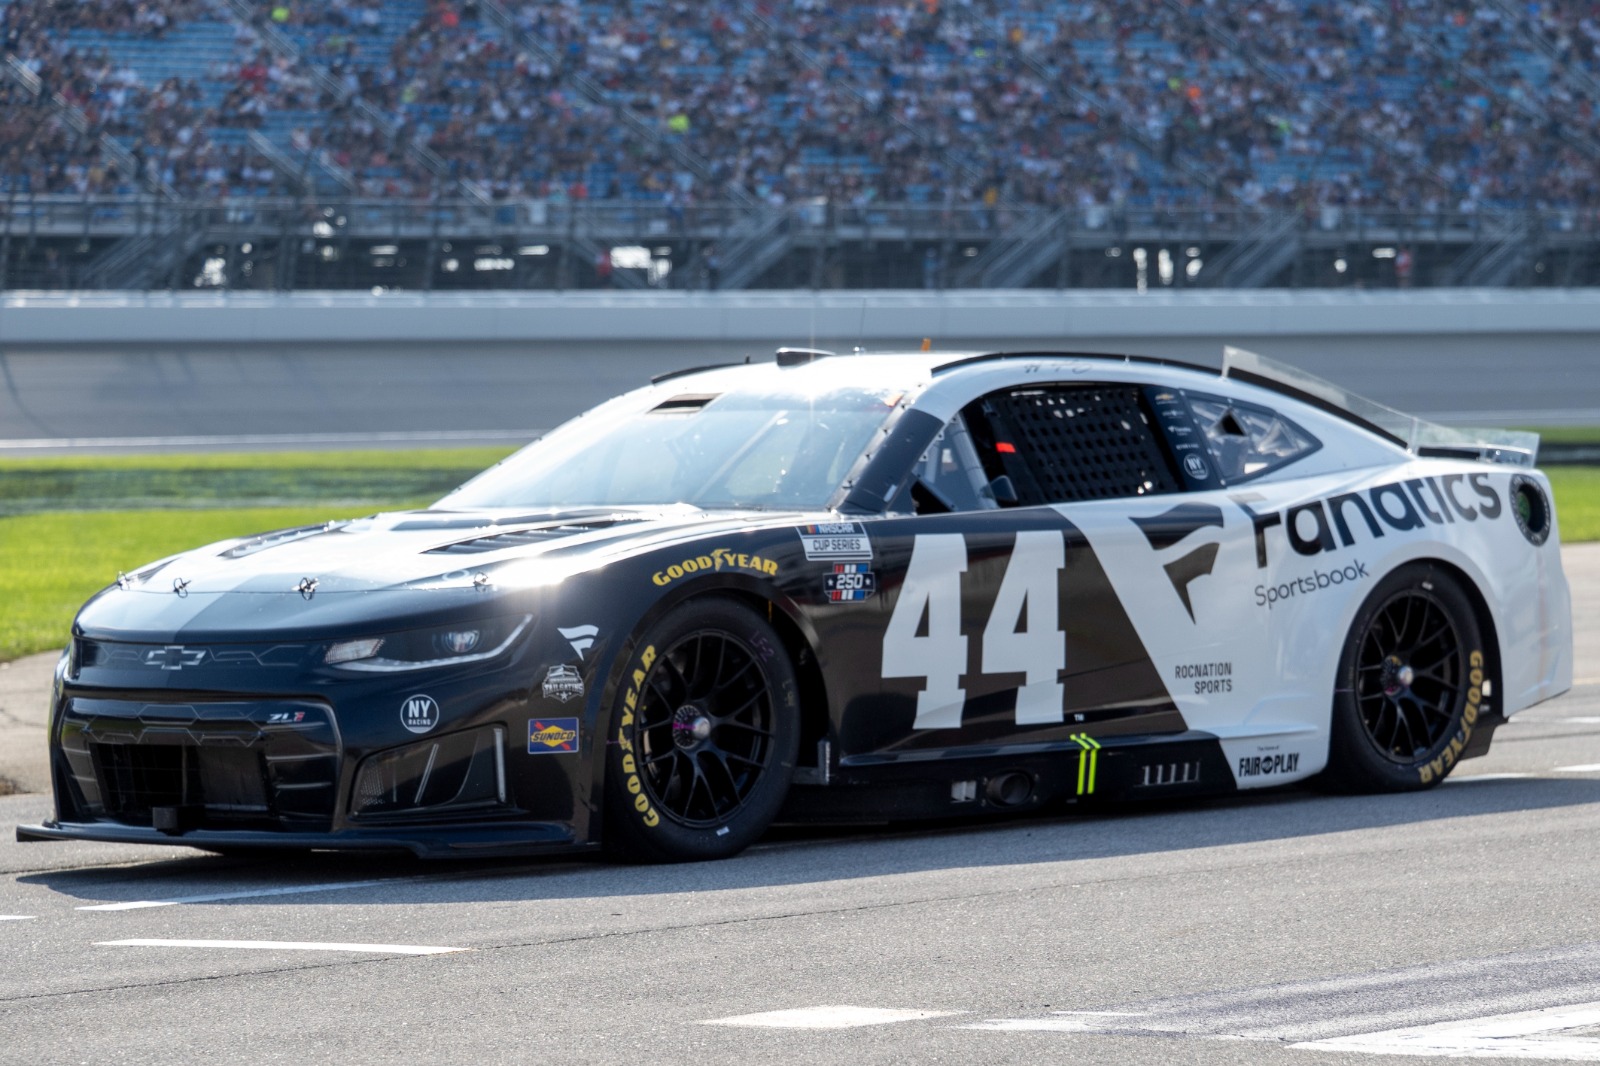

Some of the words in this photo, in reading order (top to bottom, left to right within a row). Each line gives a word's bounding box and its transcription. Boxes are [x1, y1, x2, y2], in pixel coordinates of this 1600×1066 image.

[818, 523, 855, 533] NASCAR
[813, 540, 830, 551] CUP
[832, 539, 861, 550] SERIES
[652, 548, 779, 586] GOODYEAR
[836, 574, 864, 589] 250
[1254, 559, 1371, 610] Sportsbook
[881, 530, 1066, 729] 44
[1175, 662, 1232, 679] ROCNATION
[1194, 679, 1232, 694] SPORTS
[408, 700, 431, 718] NY
[1418, 650, 1484, 785] GOODYEAR
[532, 731, 575, 742] SUNOCO
[618, 644, 660, 827] GOODYEAR
[1238, 756, 1261, 778] FAIR
[1273, 752, 1300, 774] PLAY
